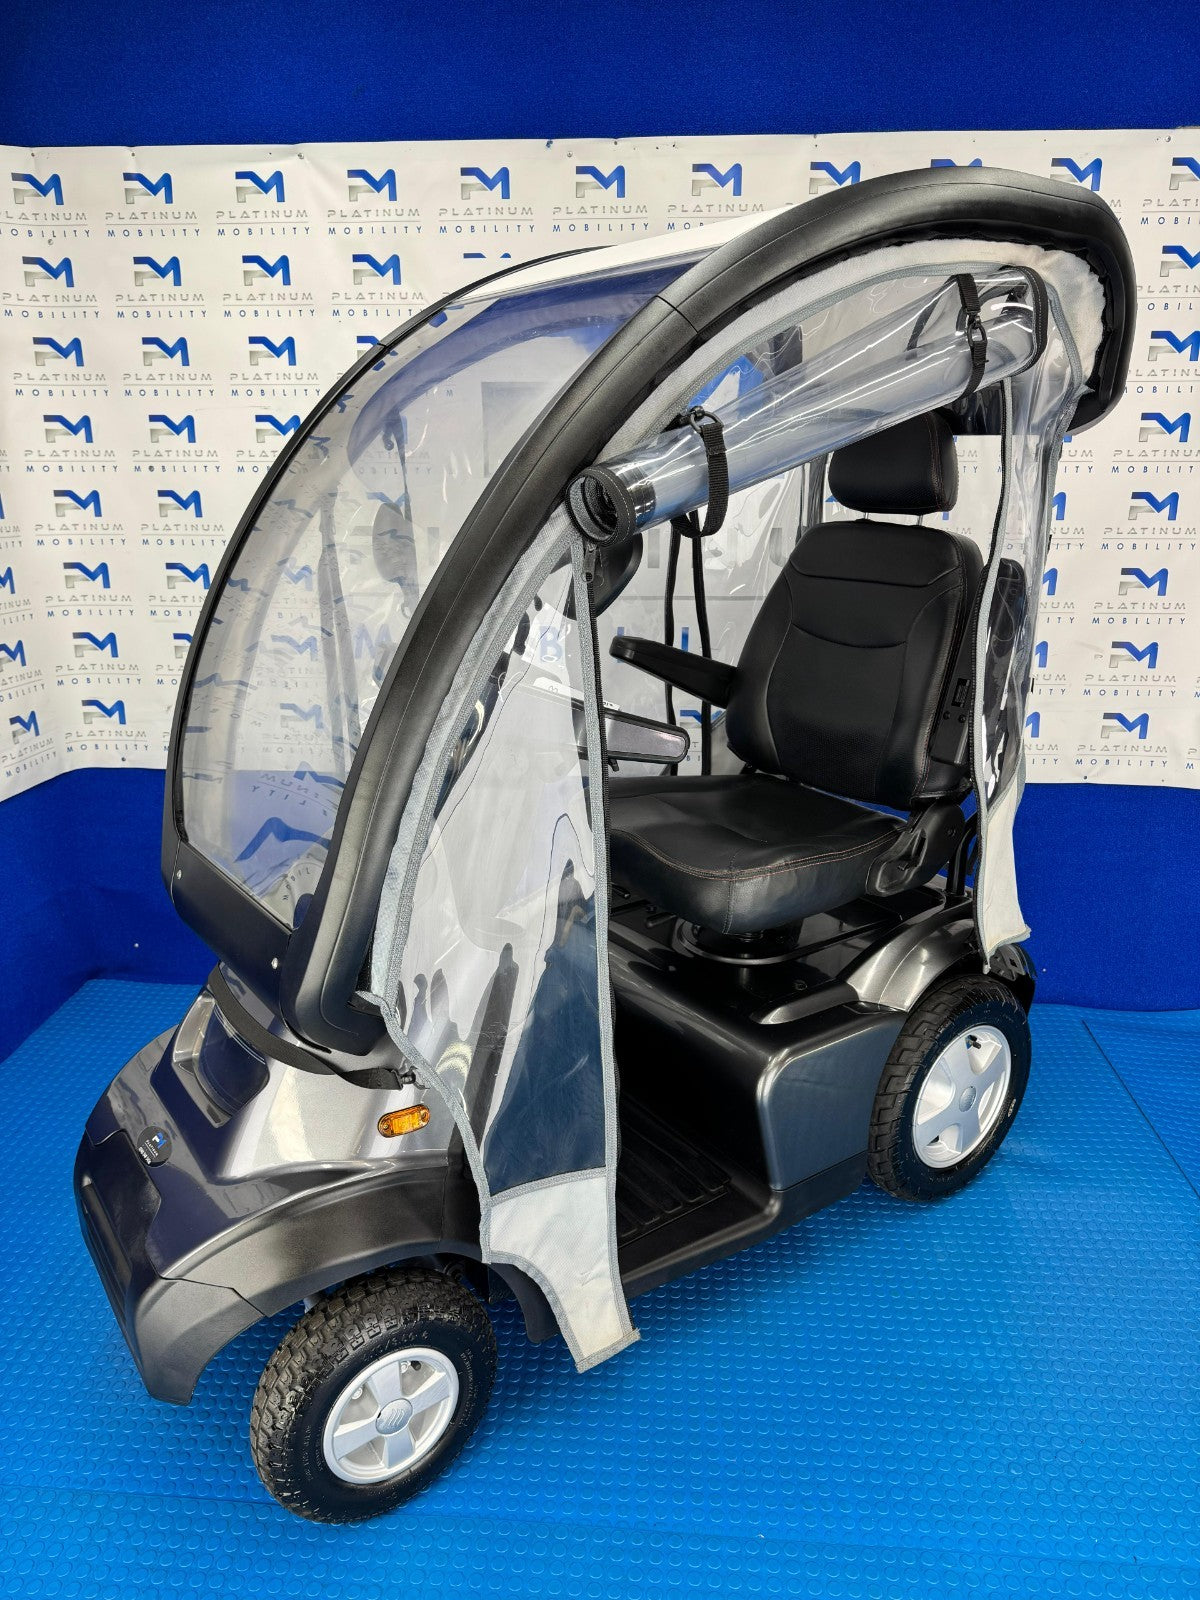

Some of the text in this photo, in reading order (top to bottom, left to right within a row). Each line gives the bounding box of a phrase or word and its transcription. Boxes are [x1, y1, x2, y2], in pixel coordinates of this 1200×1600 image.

[1142, 199, 1200, 207] PLATI
[439, 207, 533, 216] PLATINUM
[553, 205, 647, 214] PLATINUM
[668, 204, 764, 212] PLATINUM
[0, 211, 87, 221] LATINUM
[105, 211, 197, 220] PLATINUM
[216, 210, 308, 219] PLATINUM
[328, 208, 420, 218] PLATINUM
[1141, 217, 1200, 225] MOBI
[217, 227, 309, 236] MOBILITY
[328, 226, 421, 235] MOBILITY
[440, 225, 534, 233] MOBILITY
[553, 223, 648, 232] MOBILITY
[0, 228, 90, 238] OBILITY
[107, 229, 199, 237] MOBILITY
[2, 293, 97, 302] PLATINUM
[115, 294, 204, 302] PLATINUM
[223, 293, 312, 301] PLATINUM
[332, 292, 423, 300] PLATINUM
[4, 309, 99, 318] MOBILITY
[117, 310, 206, 318] MOBILITY
[224, 309, 315, 317] MOBILITY
[332, 309, 422, 318] MOBILIT
[13, 373, 106, 381] PLATINUM
[16, 389, 108, 397] MOBILITY
[37, 538, 126, 546] MOBILITY
[142, 539, 226, 547] MOBILITY
[1101, 543, 1196, 551] MOBILITY
[45, 595, 131, 603] PLATINUM
[47, 609, 134, 617] MOBILITY
[56, 664, 139, 672] PLATINUM
[57, 678, 141, 686] MOBILITY
[1085, 674, 1176, 682] PLATINUM
[1083, 689, 1176, 697] MOBILITY
[65, 730, 146, 739] PLATINUM
[2, 738, 54, 763] PLATINUM
[67, 744, 148, 753] MOBILITY
[1078, 745, 1167, 753] PLATINUM
[6, 751, 57, 777] MOBILITY
[1075, 759, 1167, 767] MOBILITY
